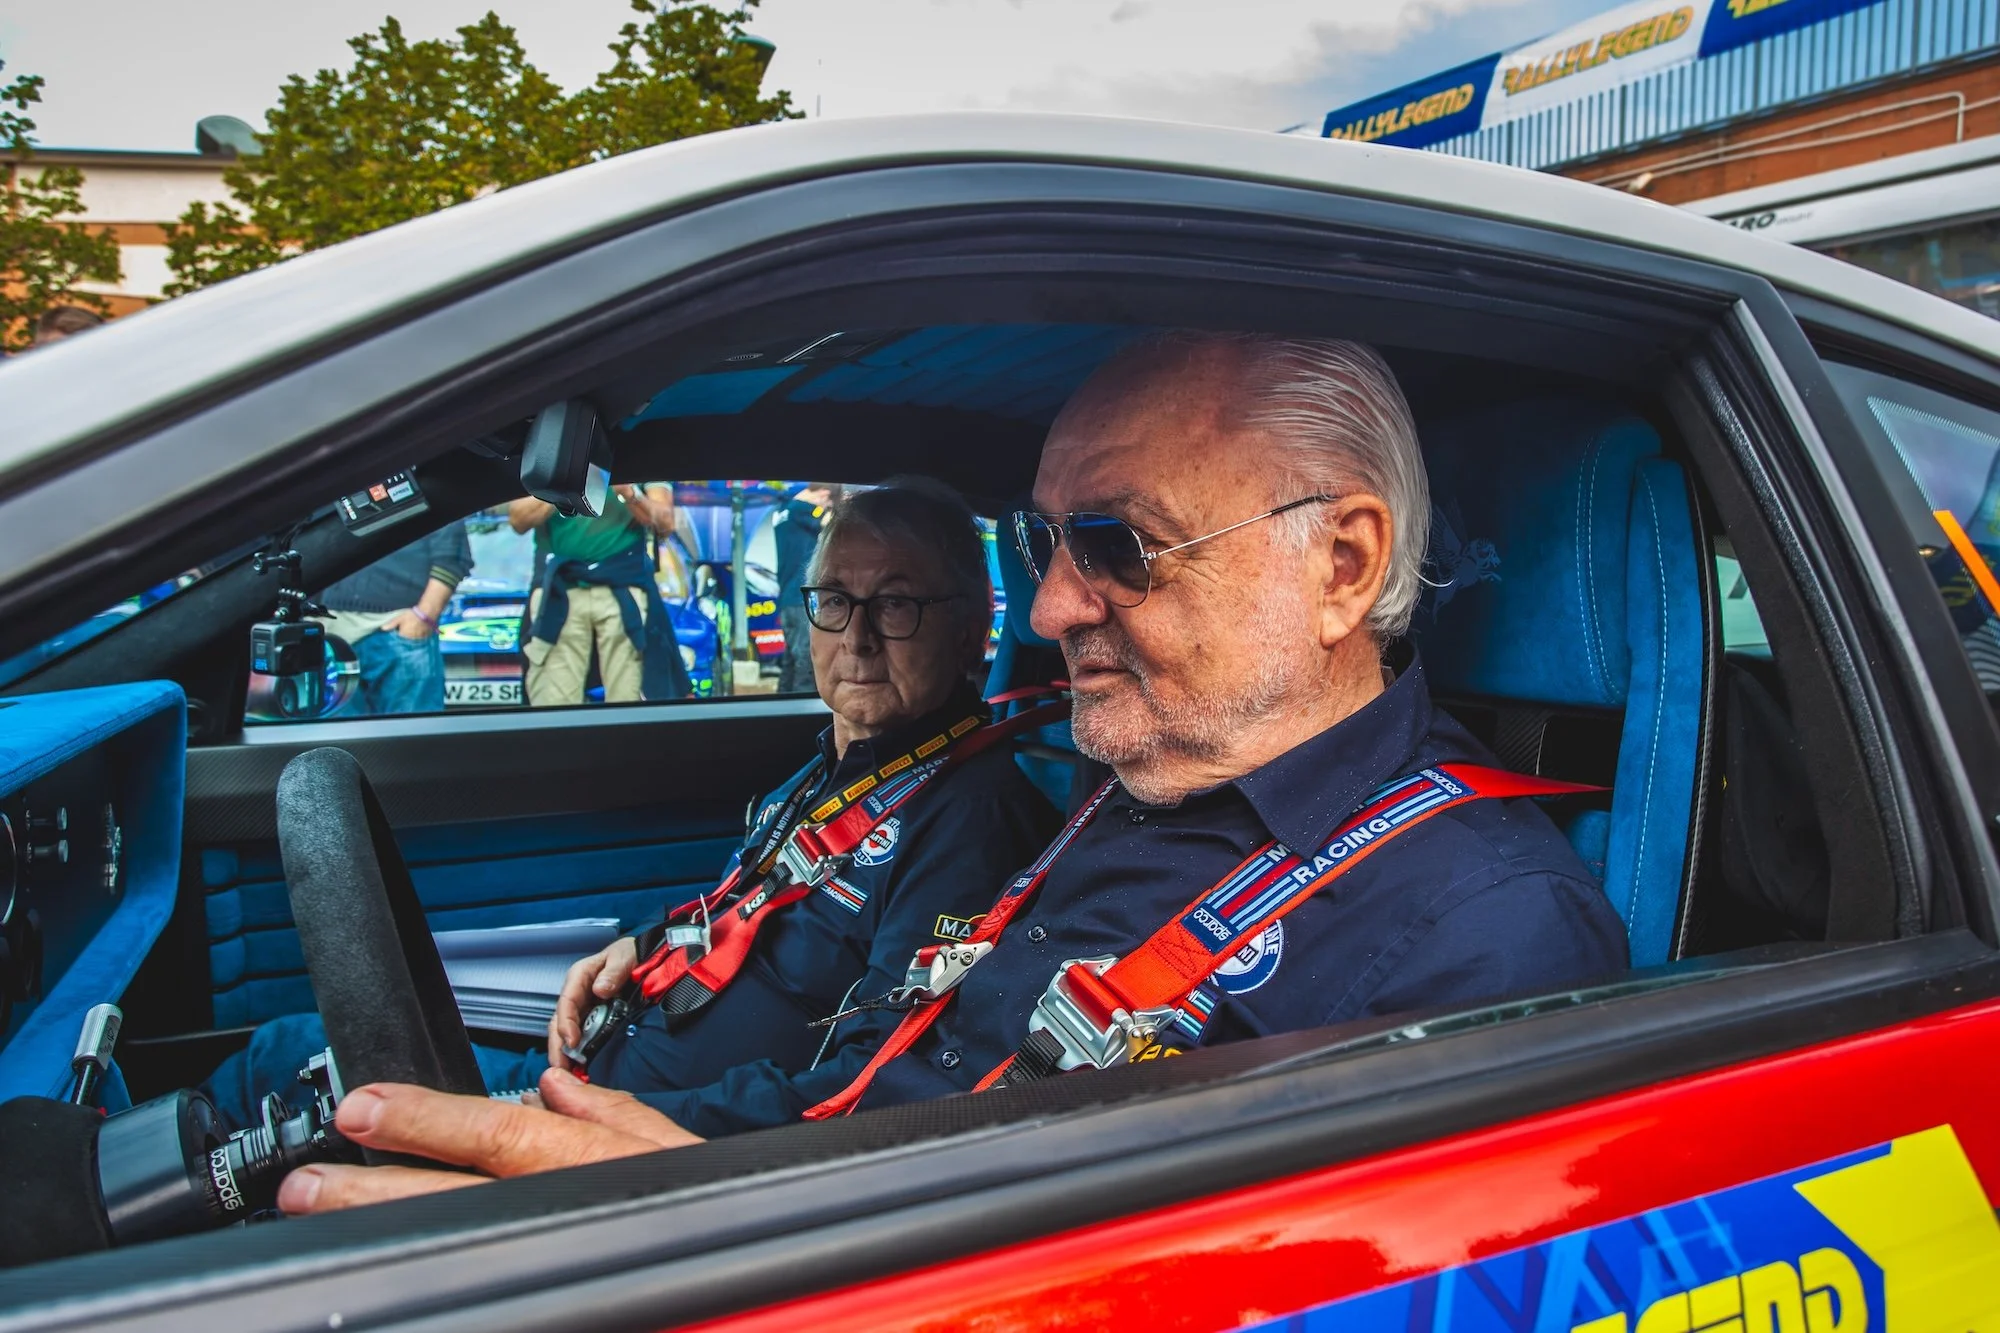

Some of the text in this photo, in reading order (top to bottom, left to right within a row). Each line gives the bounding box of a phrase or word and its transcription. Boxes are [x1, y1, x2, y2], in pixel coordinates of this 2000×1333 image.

[1502, 5, 1694, 97] RALLYLEGEND
[468, 684, 494, 701] 25
[846, 779, 875, 799] PIRELLI
[776, 803, 797, 832] NOTHING
[814, 800, 840, 821] PIRELLI
[772, 829, 781, 840] IS
[1291, 817, 1393, 885] RACING
[825, 885, 846, 903] RACING
[1193, 907, 1232, 941] sparco
[210, 1146, 244, 1211] sparco
